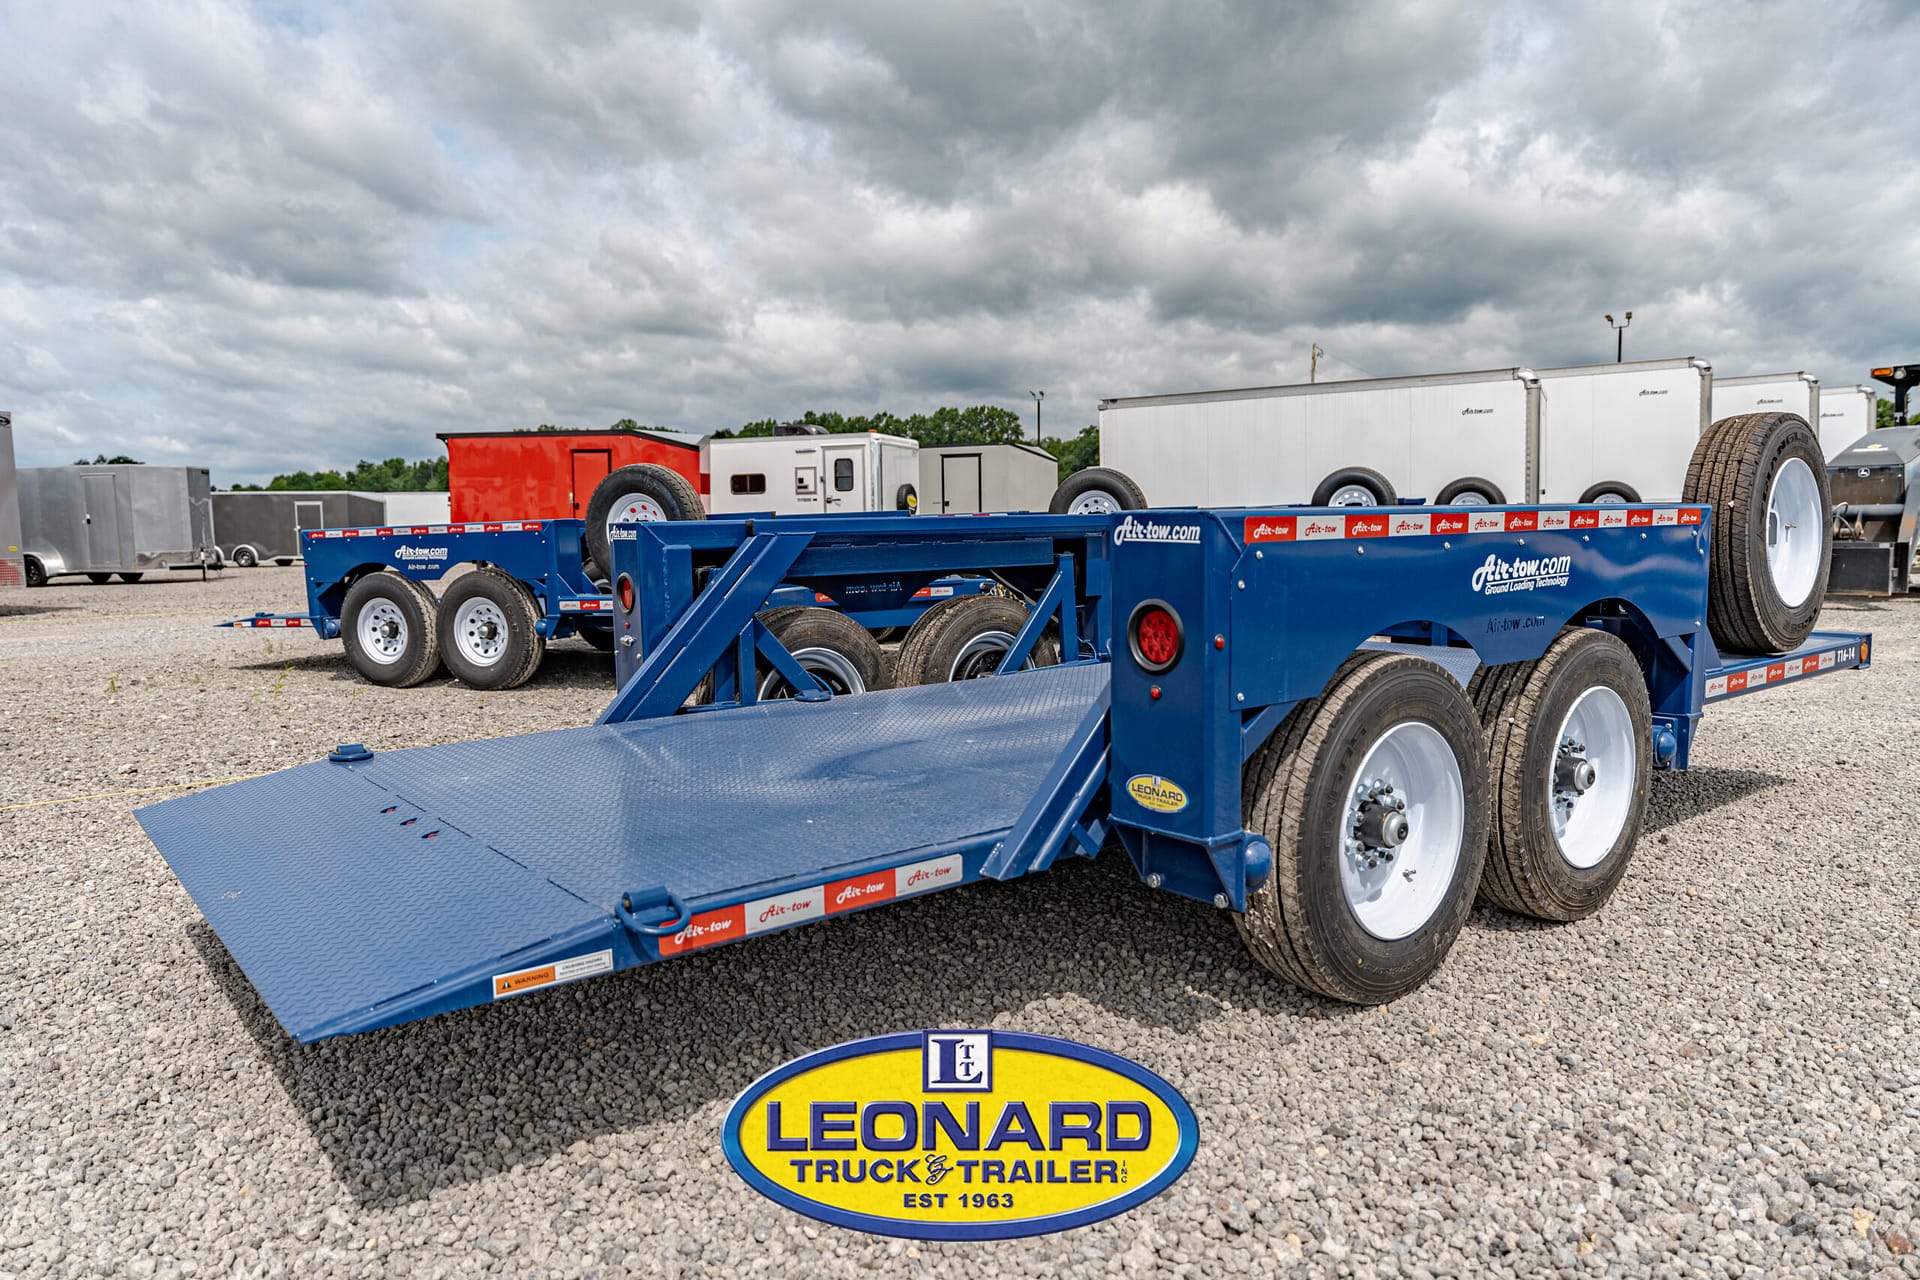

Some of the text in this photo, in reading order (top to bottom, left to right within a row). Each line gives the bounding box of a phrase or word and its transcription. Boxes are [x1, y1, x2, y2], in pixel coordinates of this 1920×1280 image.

[1114, 515, 1200, 546] Air-tow.com
[1253, 522, 1289, 539] Air-tow
[1472, 554, 1571, 592] Air-tow.com
[1485, 576, 1569, 596] Ground Loading Technology
[1132, 783, 1183, 802] LEONARD
[674, 865, 951, 945] Air-tow Air-tow Air-tow Air-tow
[515, 972, 550, 985] WARNING
